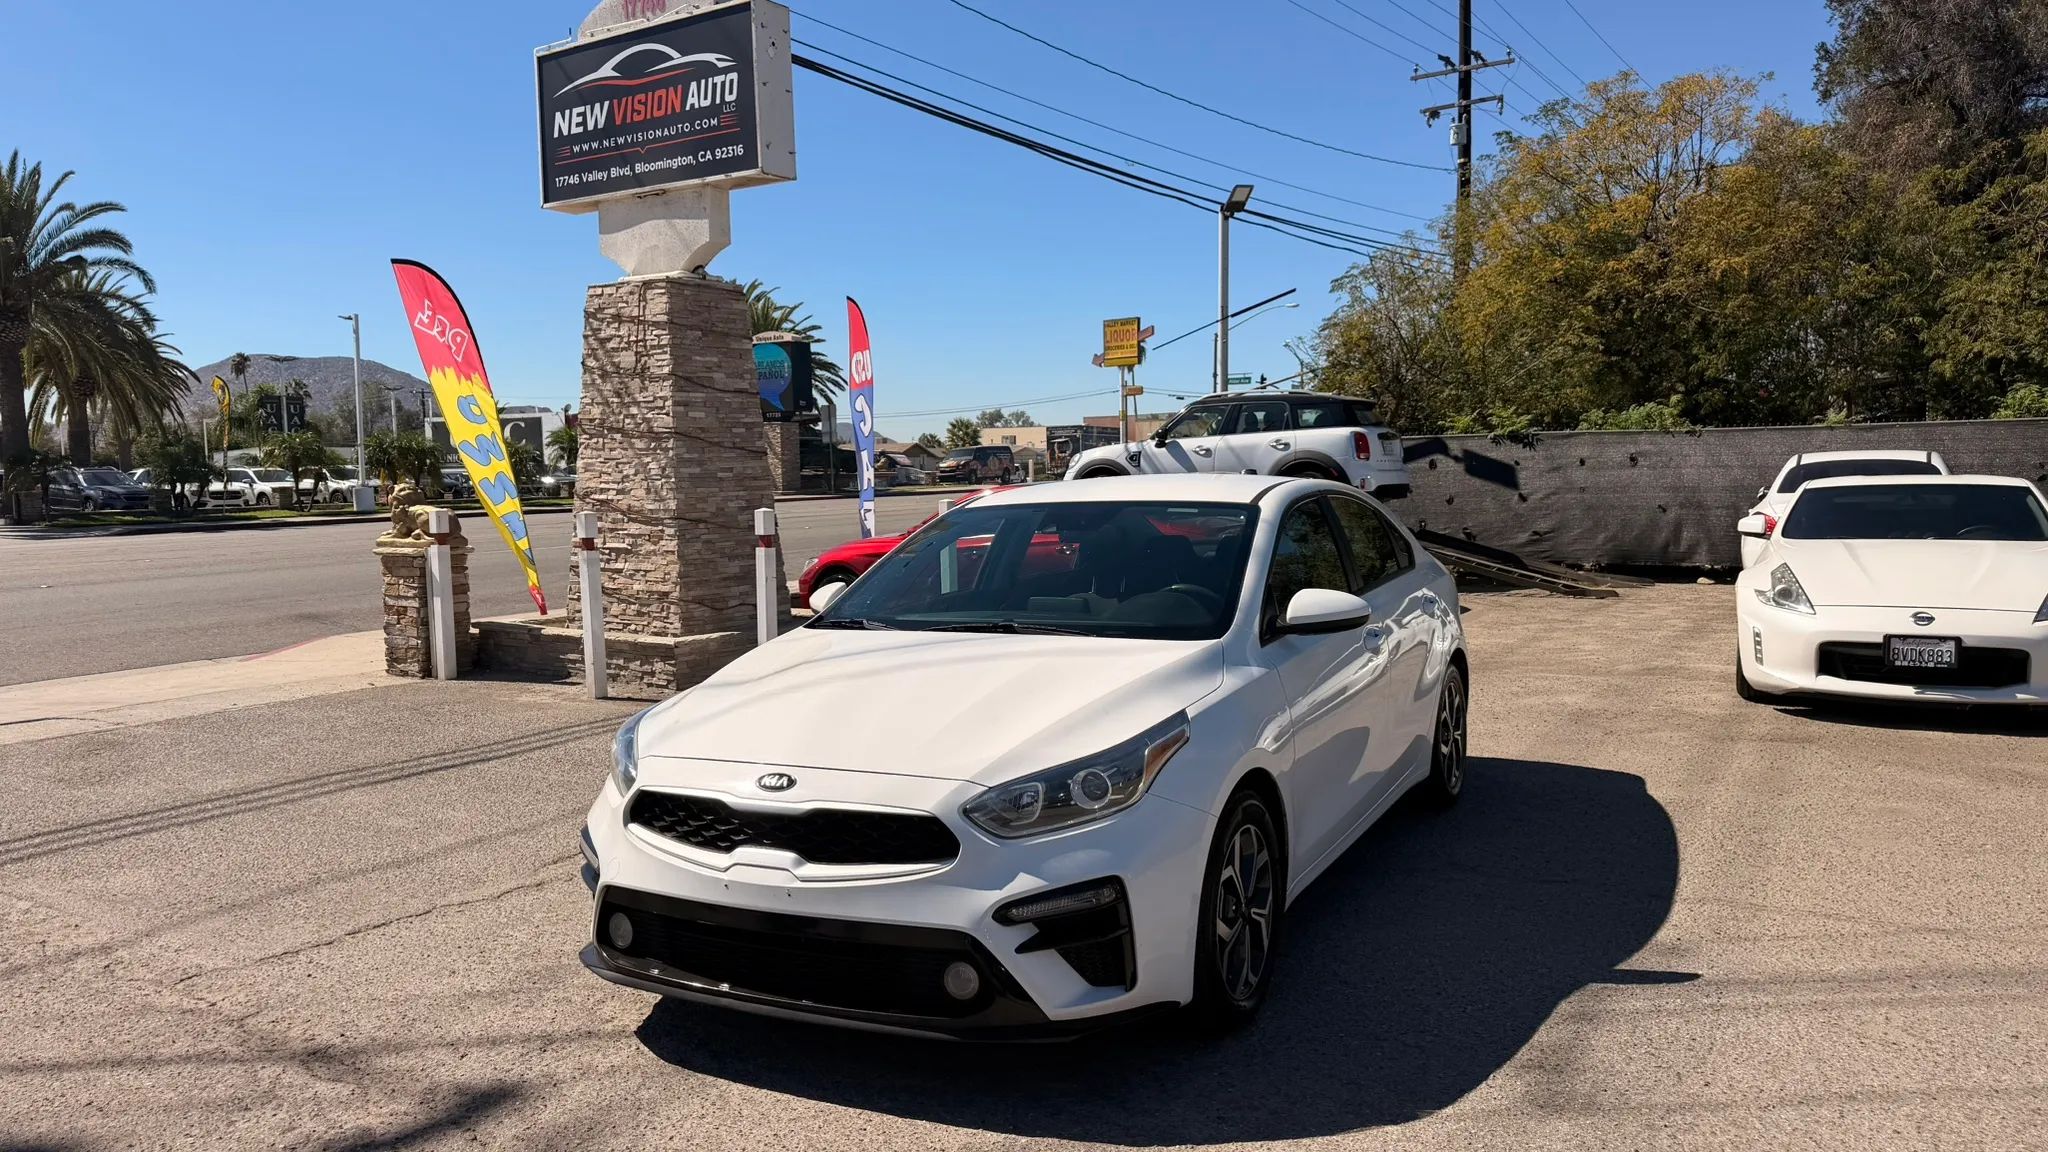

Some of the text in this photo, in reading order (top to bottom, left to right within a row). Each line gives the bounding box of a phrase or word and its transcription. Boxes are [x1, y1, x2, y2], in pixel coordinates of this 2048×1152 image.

[553, 71, 738, 138] NEW VISION AUTO
[722, 103, 736, 113] LLC
[572, 117, 718, 153] WWW.NEWVISIONAUTO.COM
[555, 144, 744, 188] 17746 Valley Blvd, Bloomington, CA 92316
[1105, 329, 1137, 343] LIQUOR
[1892, 647, 1952, 663] 8VDK883
[760, 775, 789, 787] KIA
